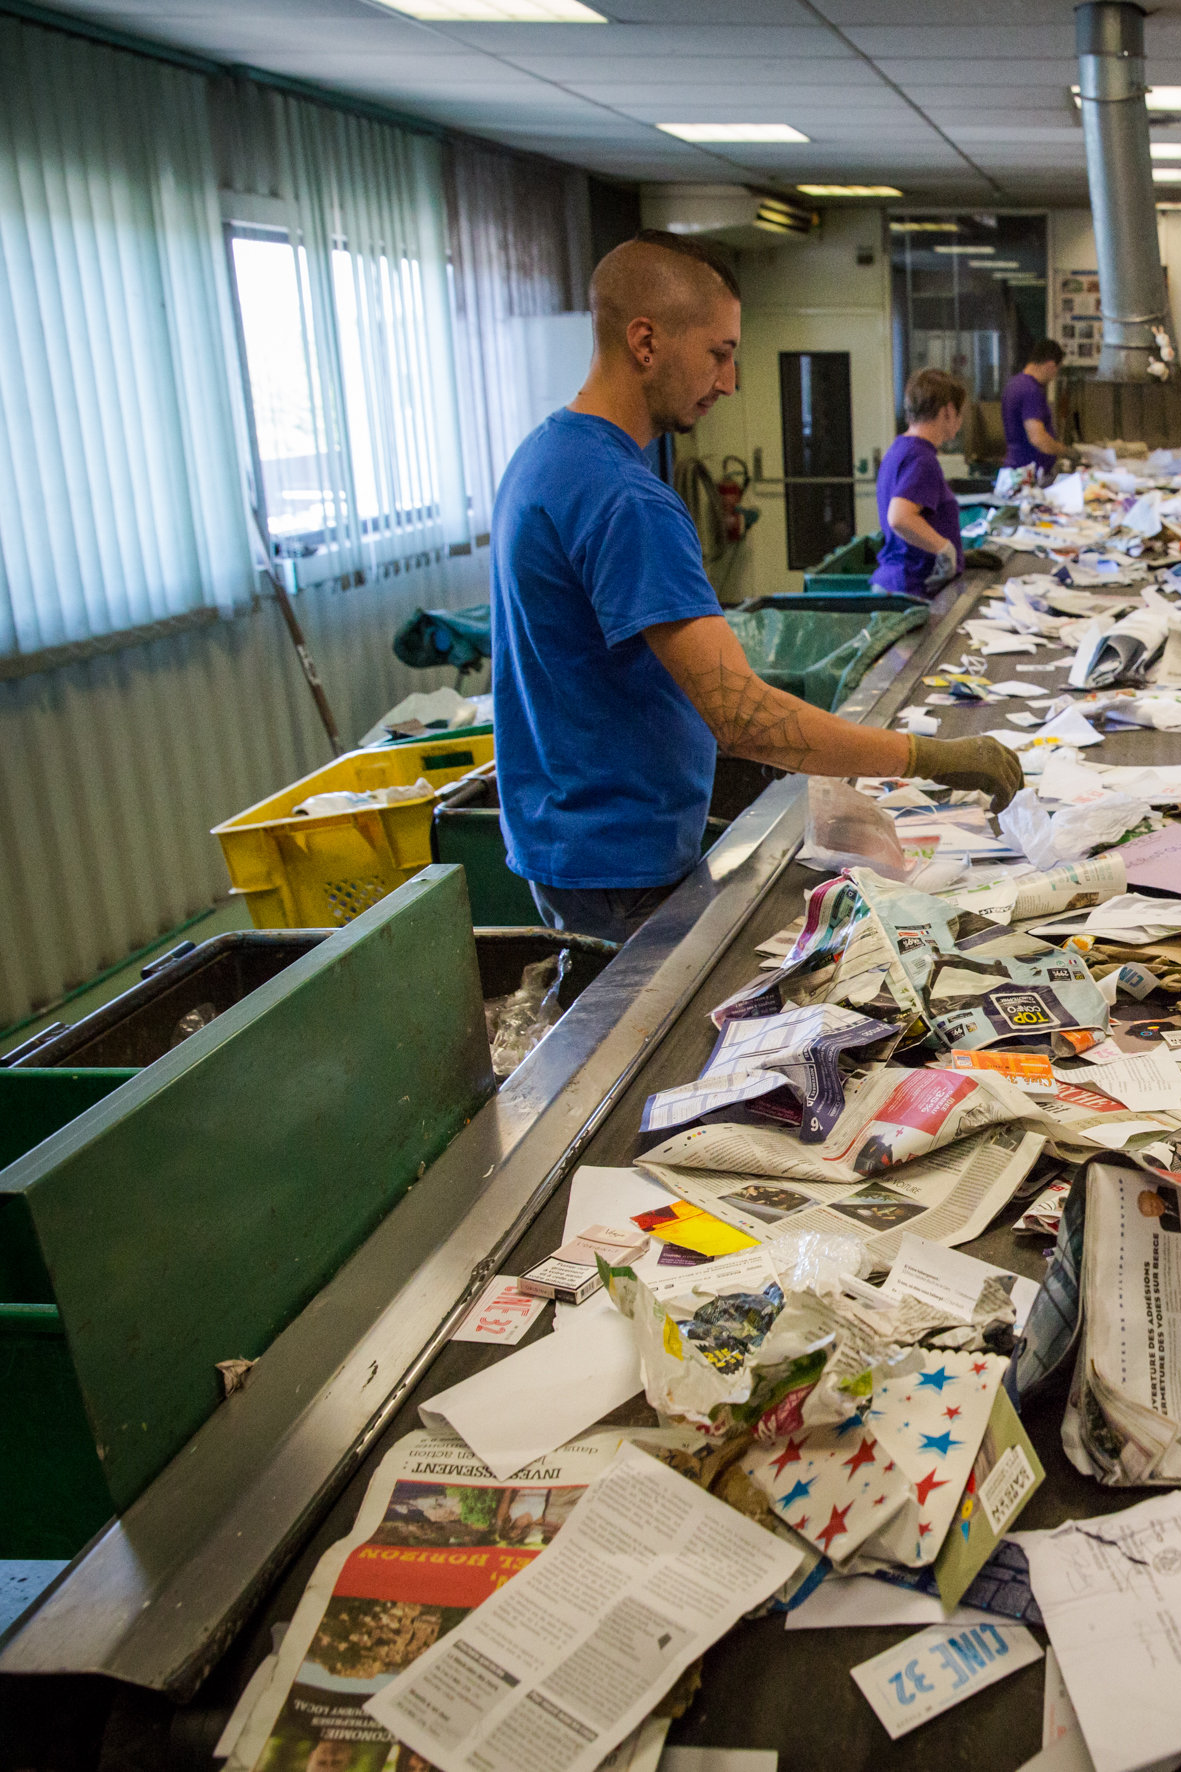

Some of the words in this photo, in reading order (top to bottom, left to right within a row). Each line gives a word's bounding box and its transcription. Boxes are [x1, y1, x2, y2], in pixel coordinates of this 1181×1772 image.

[1007, 1005, 1041, 1013] CONFO
[1013, 1011, 1049, 1024] TOP
[1152, 1232, 1160, 1270] BERGE
[1152, 1271, 1161, 1294] SUR
[1143, 1261, 1155, 1326] ADHÉSIONS
[1155, 1295, 1163, 1329] VOIES
[475, 1316, 512, 1335] 32
[1148, 1331, 1156, 1350] DES
[409, 1450, 454, 1459] action
[359, 1548, 489, 1567] HORIZON
[929, 1622, 1009, 1690] CINE
[888, 1658, 935, 1706] 32
[294, 1699, 330, 1716] LOCAL
